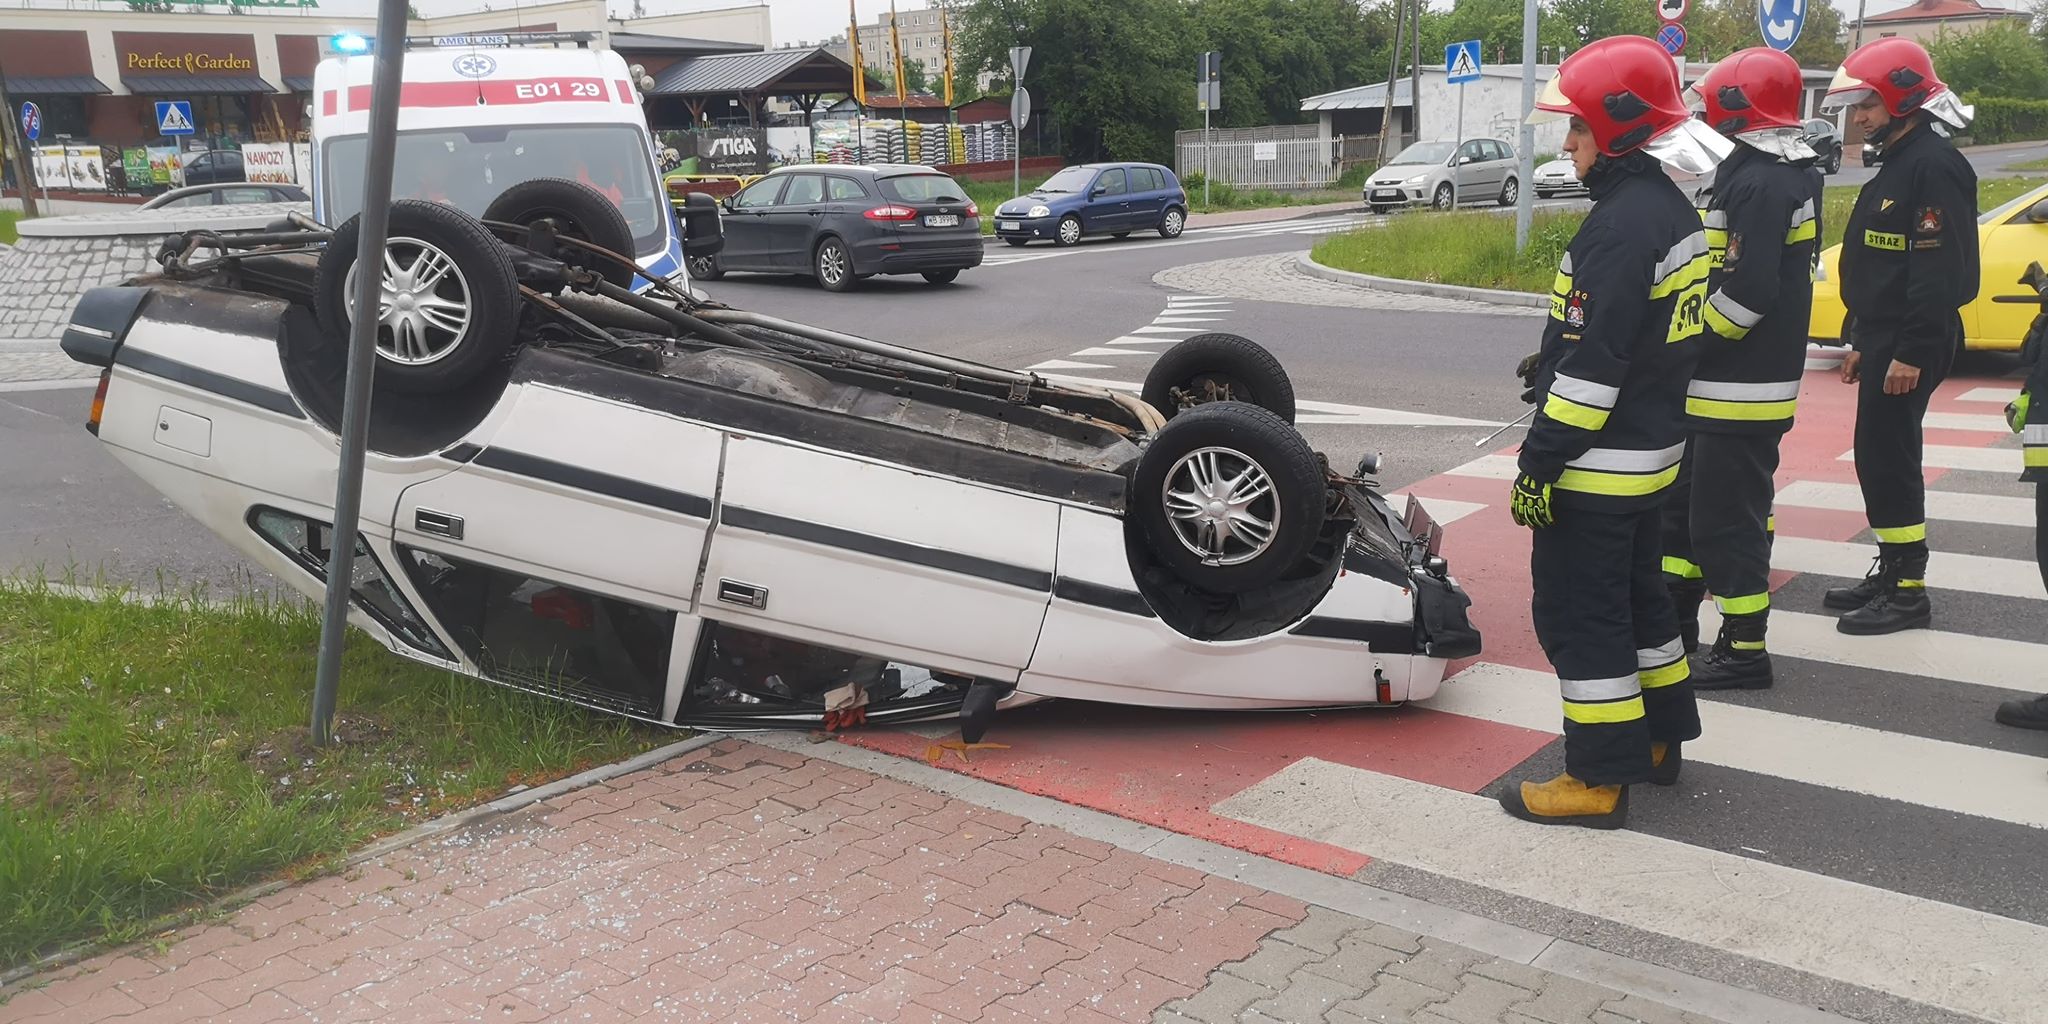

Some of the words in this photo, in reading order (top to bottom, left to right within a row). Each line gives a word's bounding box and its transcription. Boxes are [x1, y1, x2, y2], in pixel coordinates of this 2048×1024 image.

[438, 36, 505, 46] AMBULANS
[127, 52, 182, 69] Perfect
[195, 53, 251, 69] Garden
[515, 82, 561, 99] E01
[570, 82, 601, 96] 29
[709, 137, 757, 157] STIGA
[246, 151, 284, 166] NAWOZY
